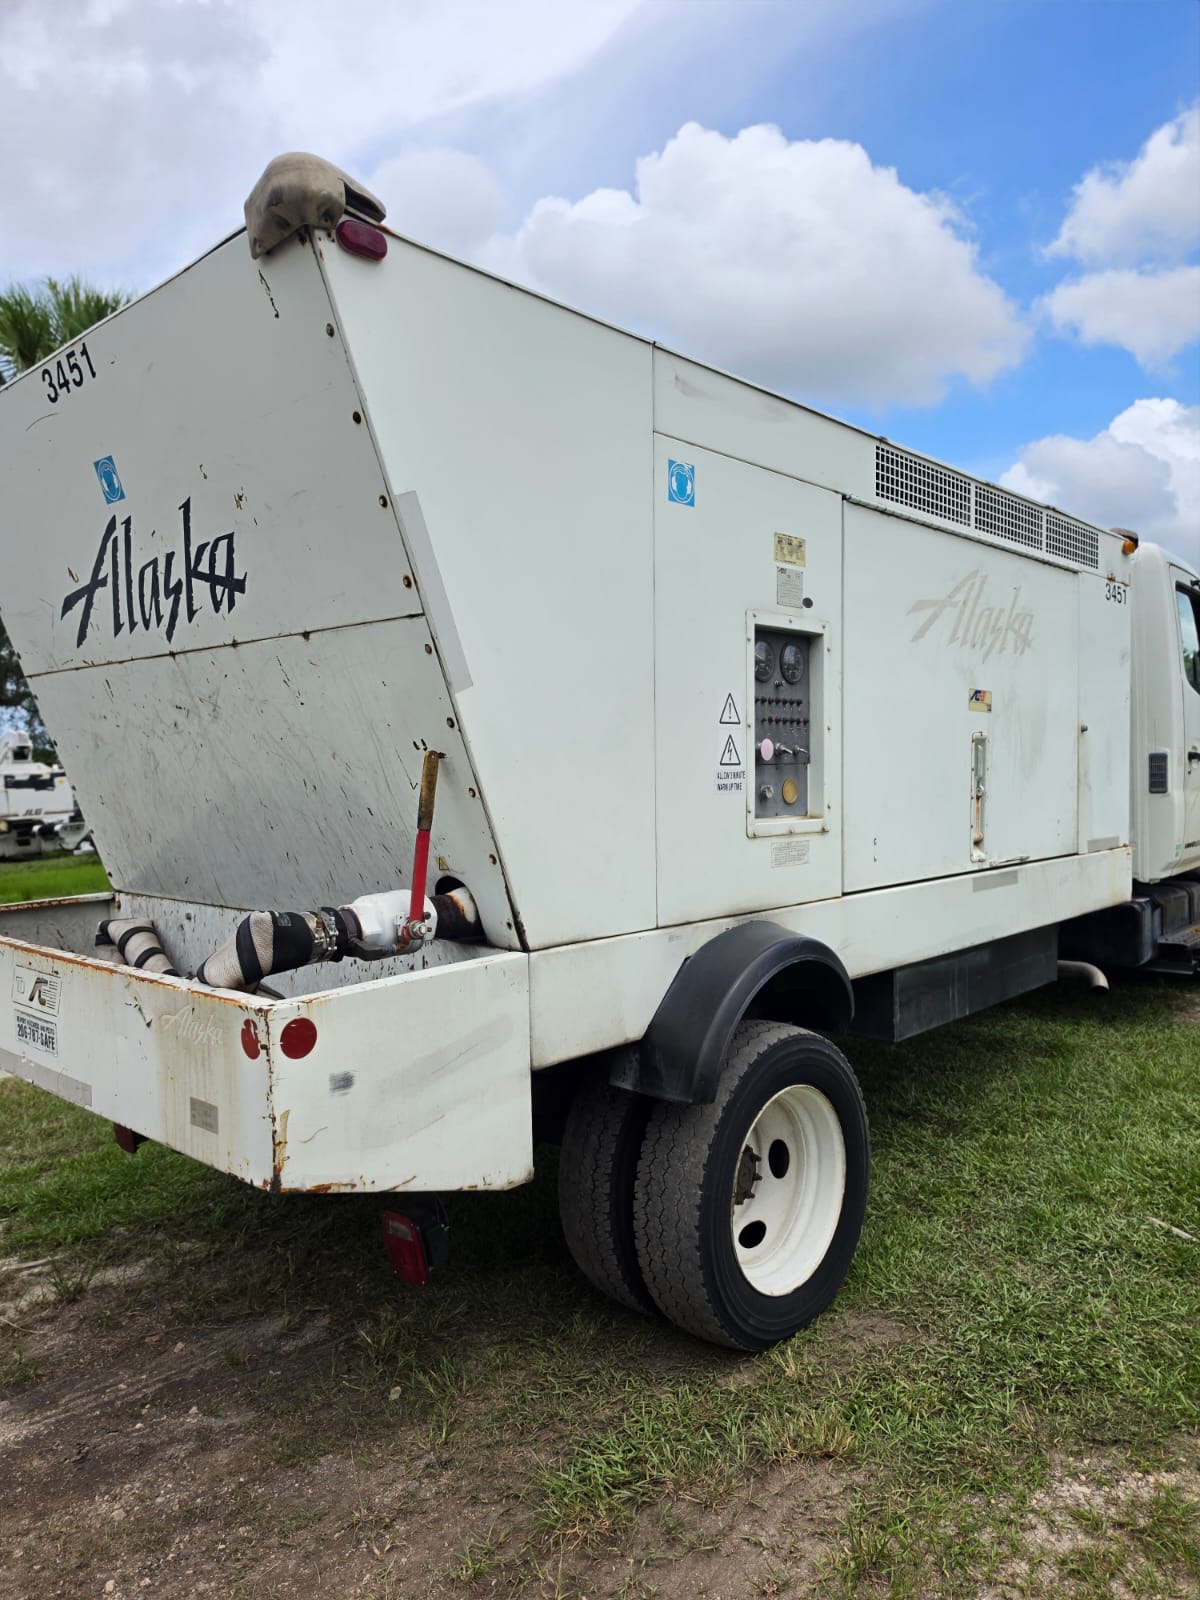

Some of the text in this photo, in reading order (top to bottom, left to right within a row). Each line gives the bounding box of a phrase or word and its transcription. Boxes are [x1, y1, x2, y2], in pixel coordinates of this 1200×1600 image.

[41, 342, 97, 404] 3451
[60, 496, 248, 649] Alaska
[1105, 582, 1127, 605] 3451
[905, 568, 1036, 665] Alaska
[22, 808, 43, 816] JLG
